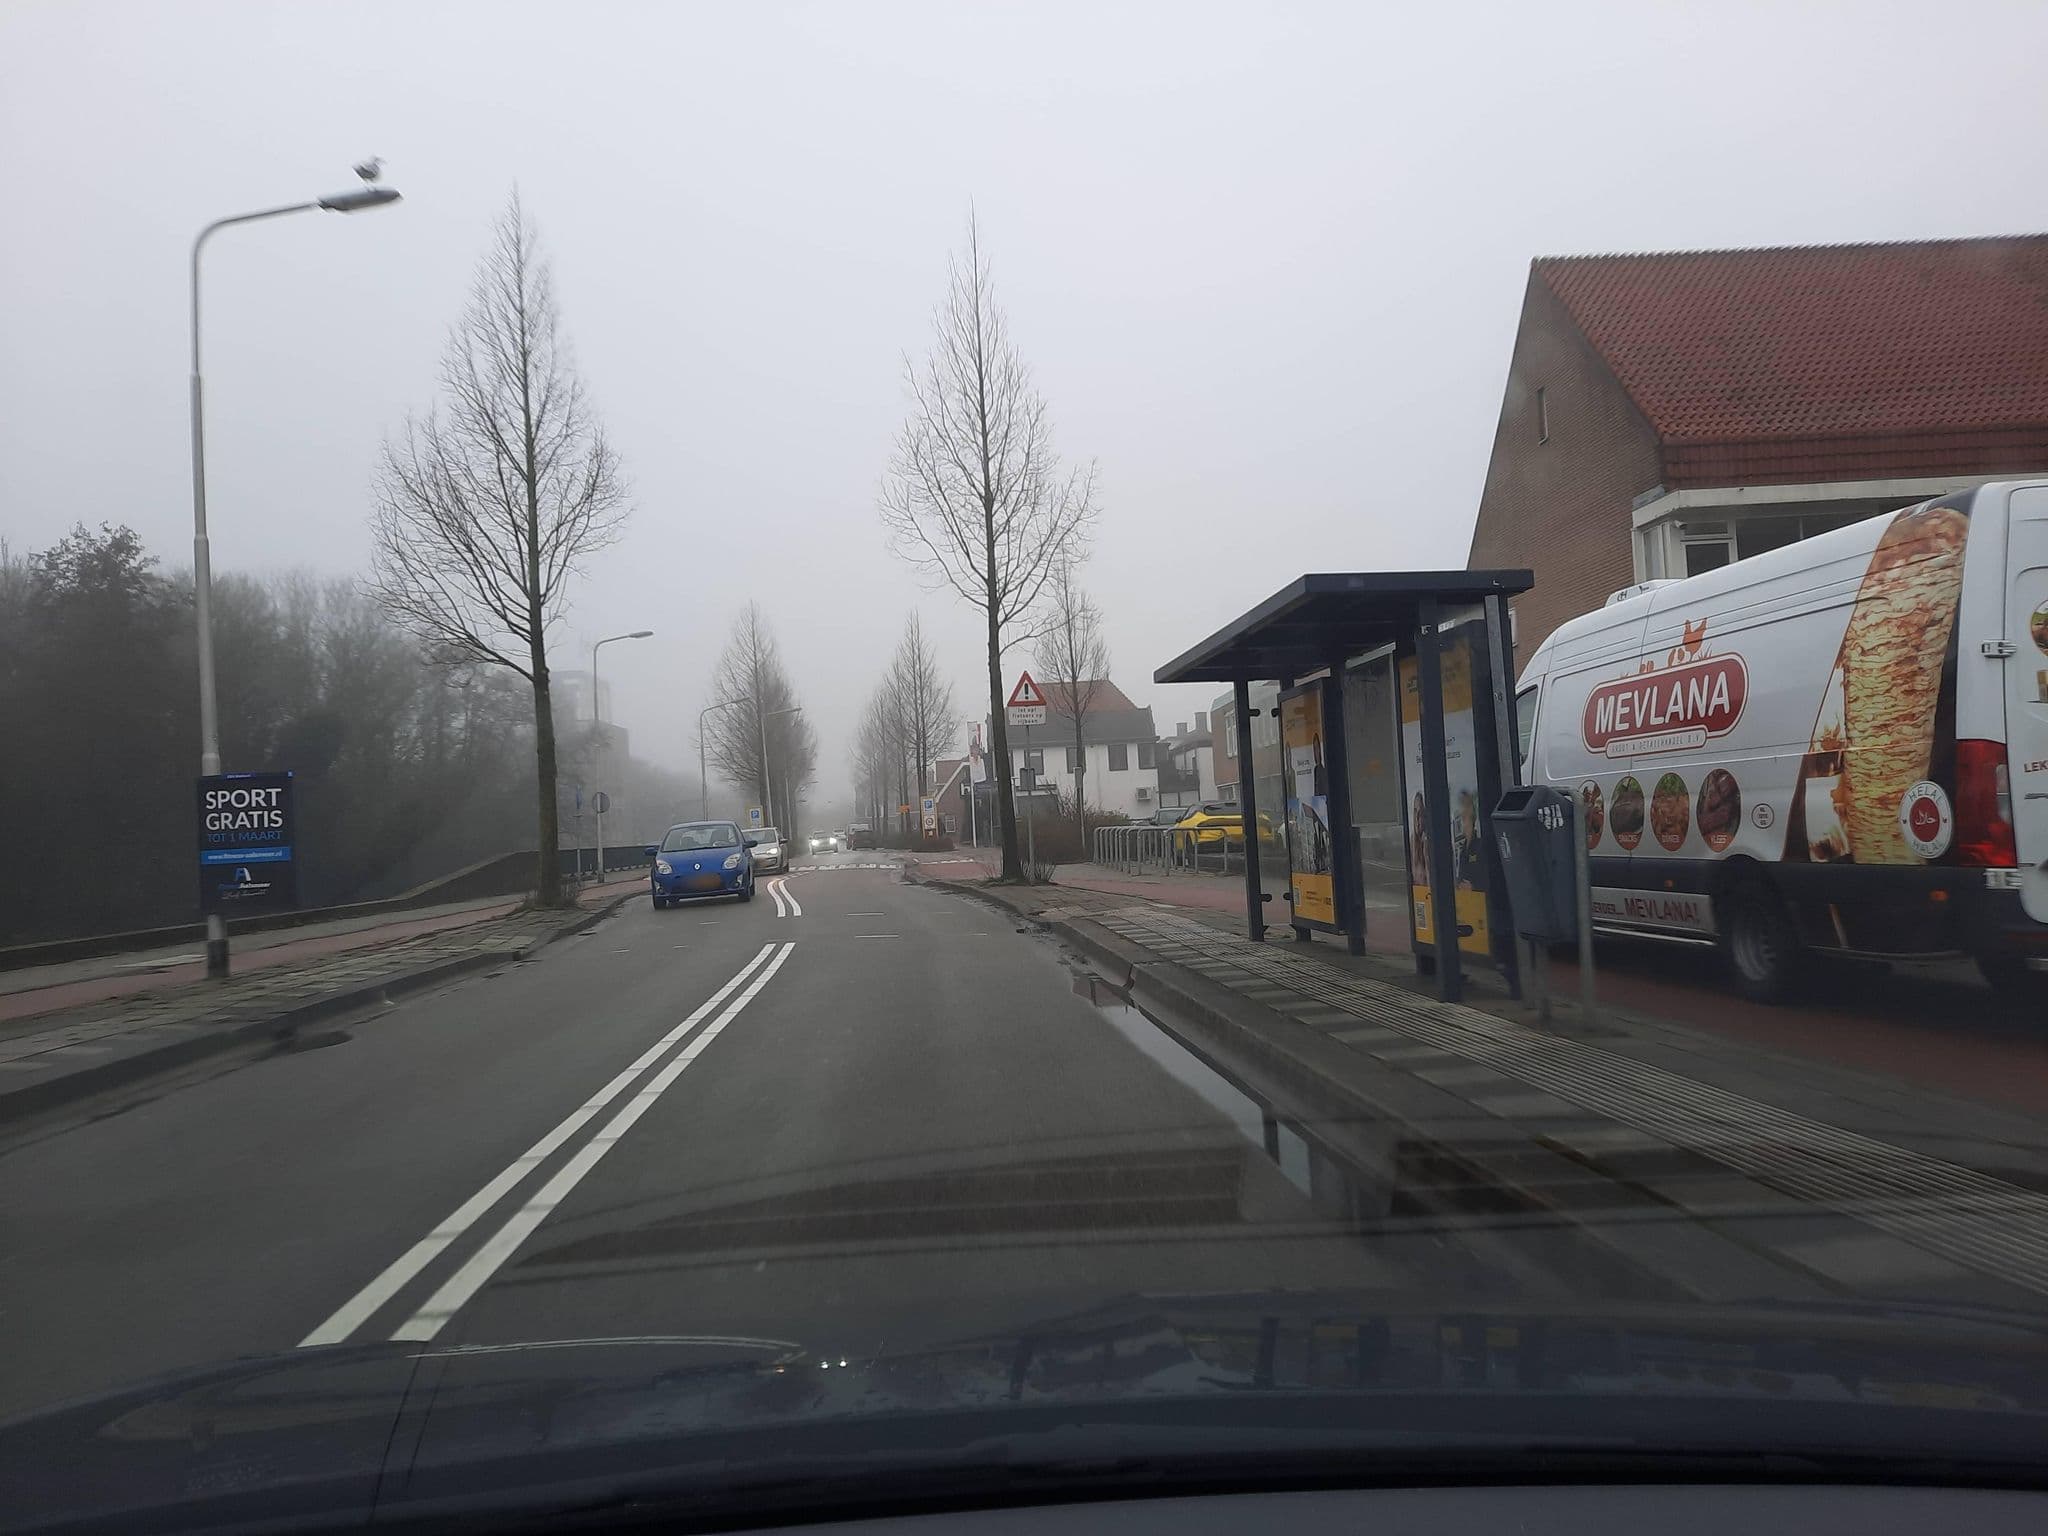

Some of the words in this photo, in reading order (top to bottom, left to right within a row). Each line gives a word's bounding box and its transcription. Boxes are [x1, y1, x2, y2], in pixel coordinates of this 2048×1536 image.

[1594, 671, 1731, 734] MEVLANA
[205, 788, 282, 810] SPORT
[205, 810, 283, 831] GRATIS
[207, 833, 226, 843] TOT
[239, 830, 283, 841] MAART
[1624, 898, 1700, 922] MEVLANA!
